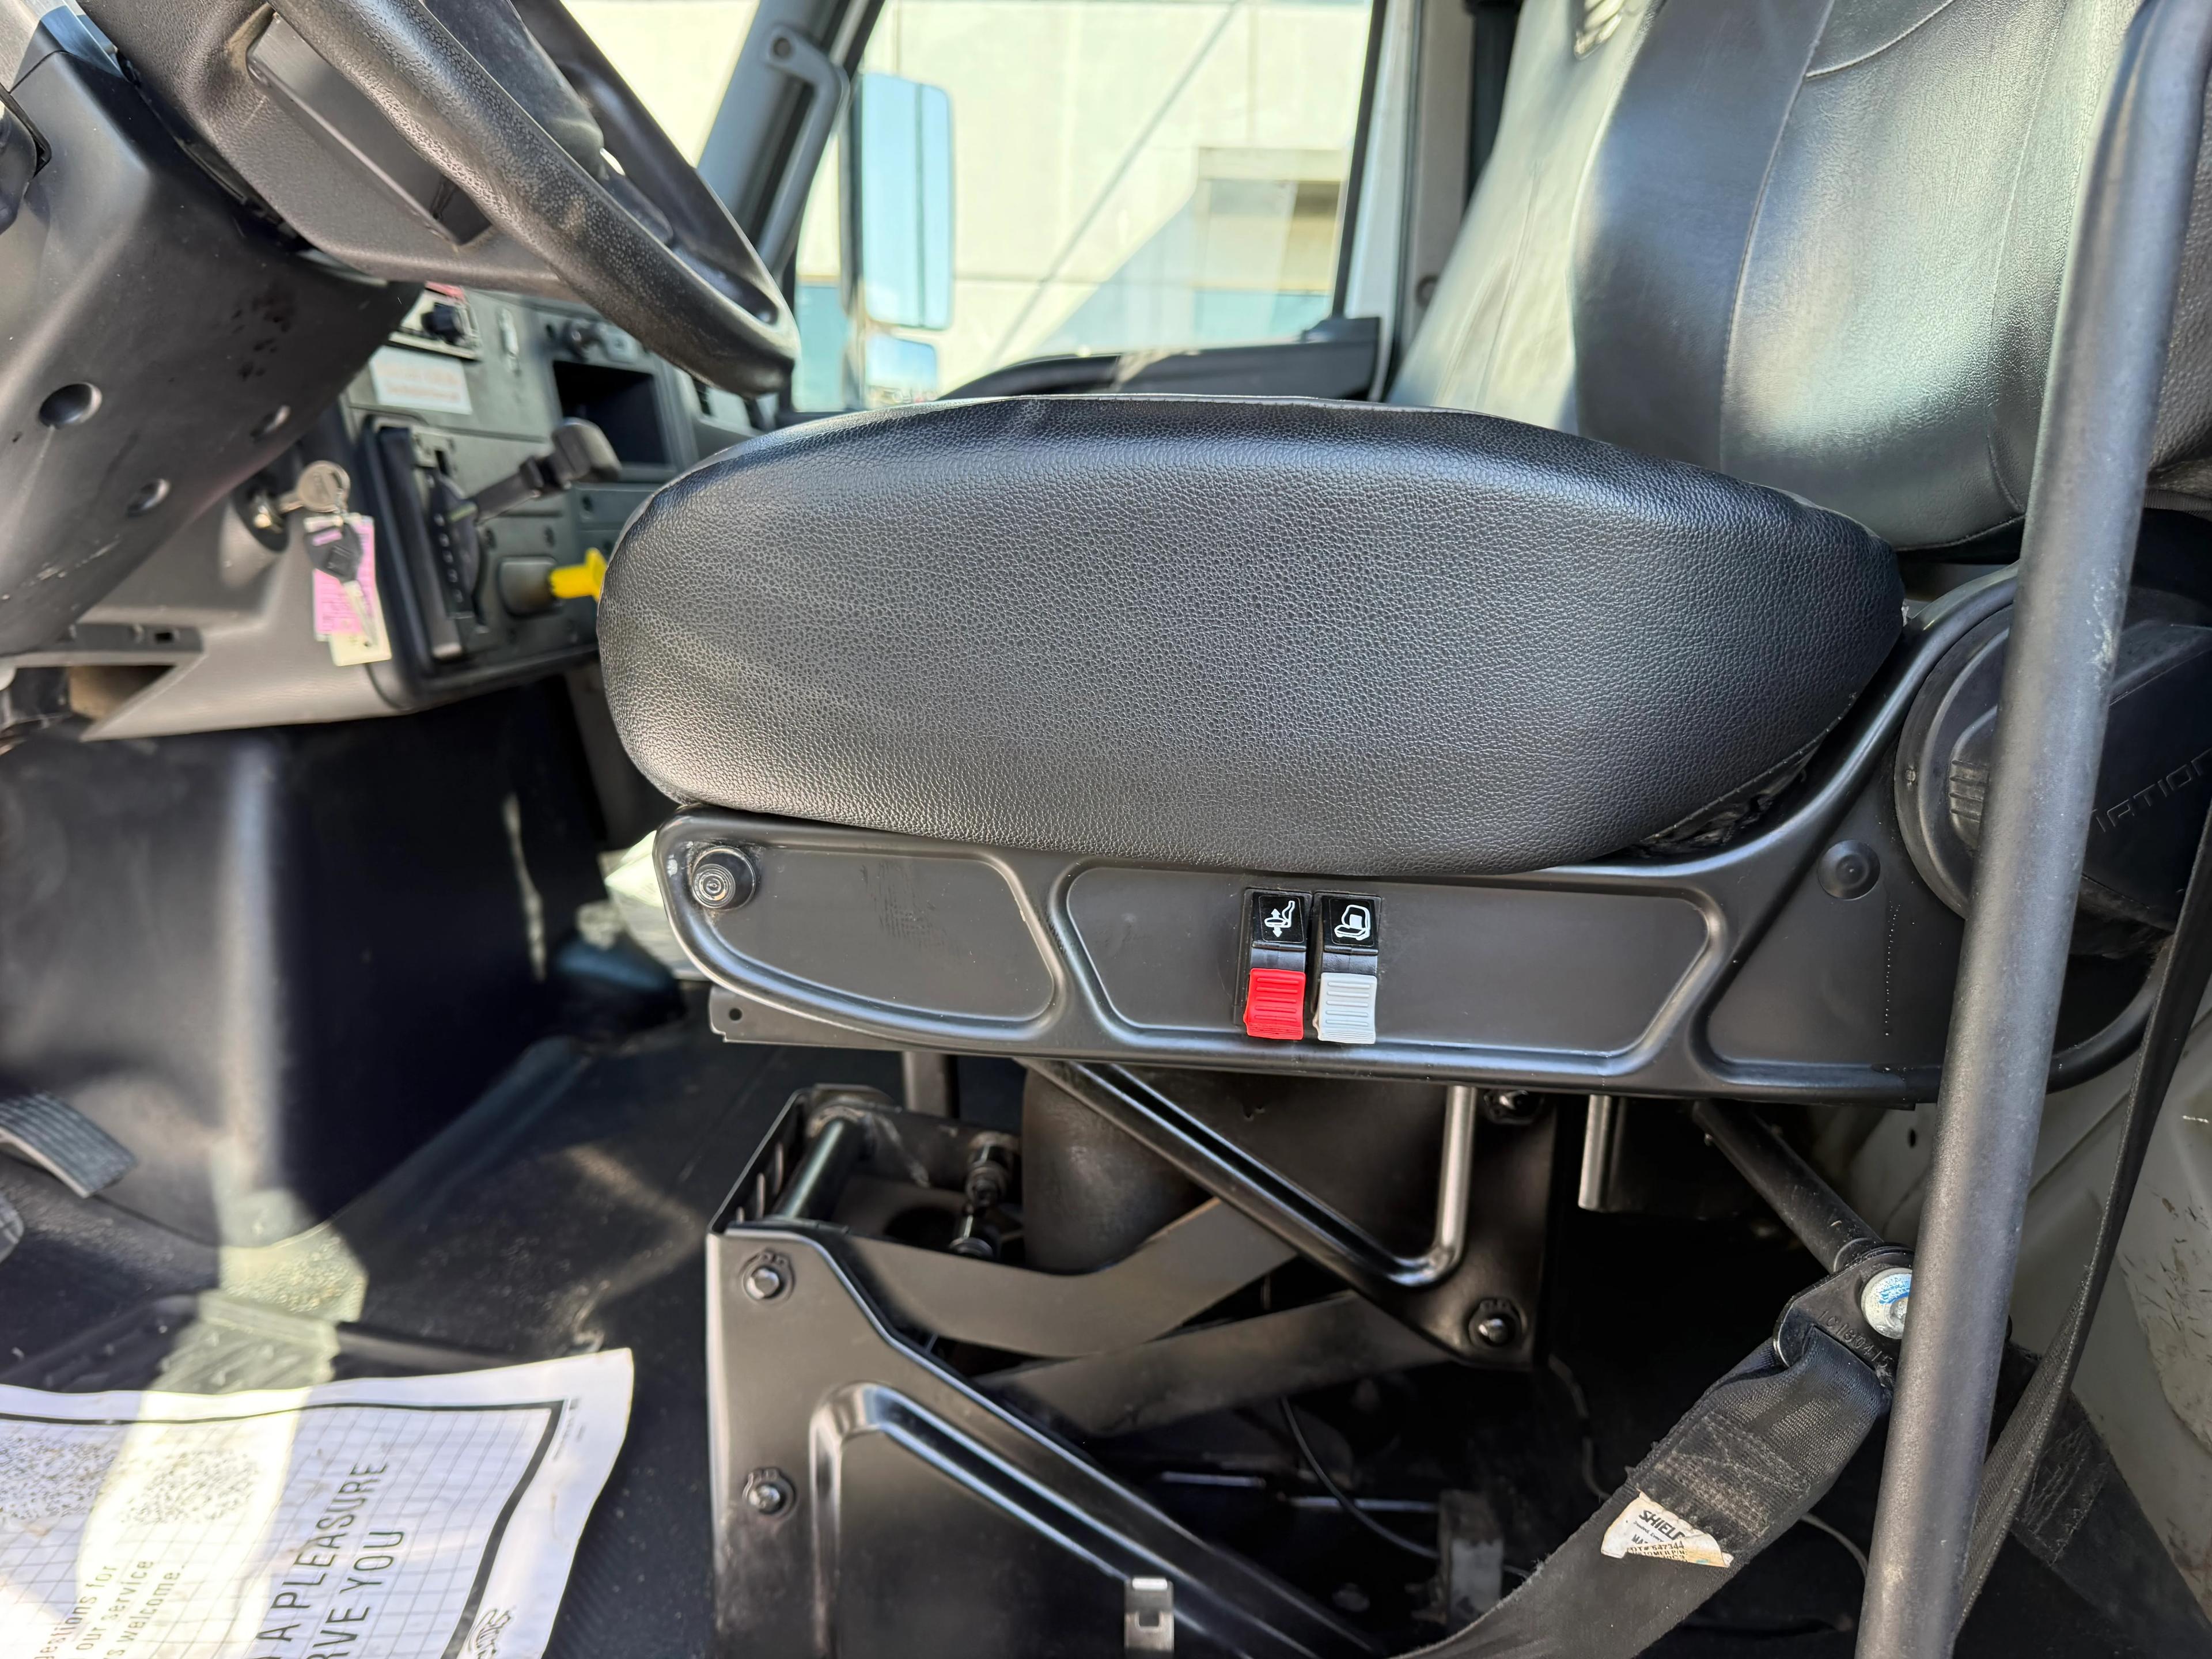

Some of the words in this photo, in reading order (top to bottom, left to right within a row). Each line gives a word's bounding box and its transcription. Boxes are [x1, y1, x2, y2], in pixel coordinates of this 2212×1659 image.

[270, 1461, 389, 1609] PLEASURE
[339, 1531, 406, 1594] YOU
[85, 1565, 118, 1588] for
[100, 1560, 154, 1622] service
